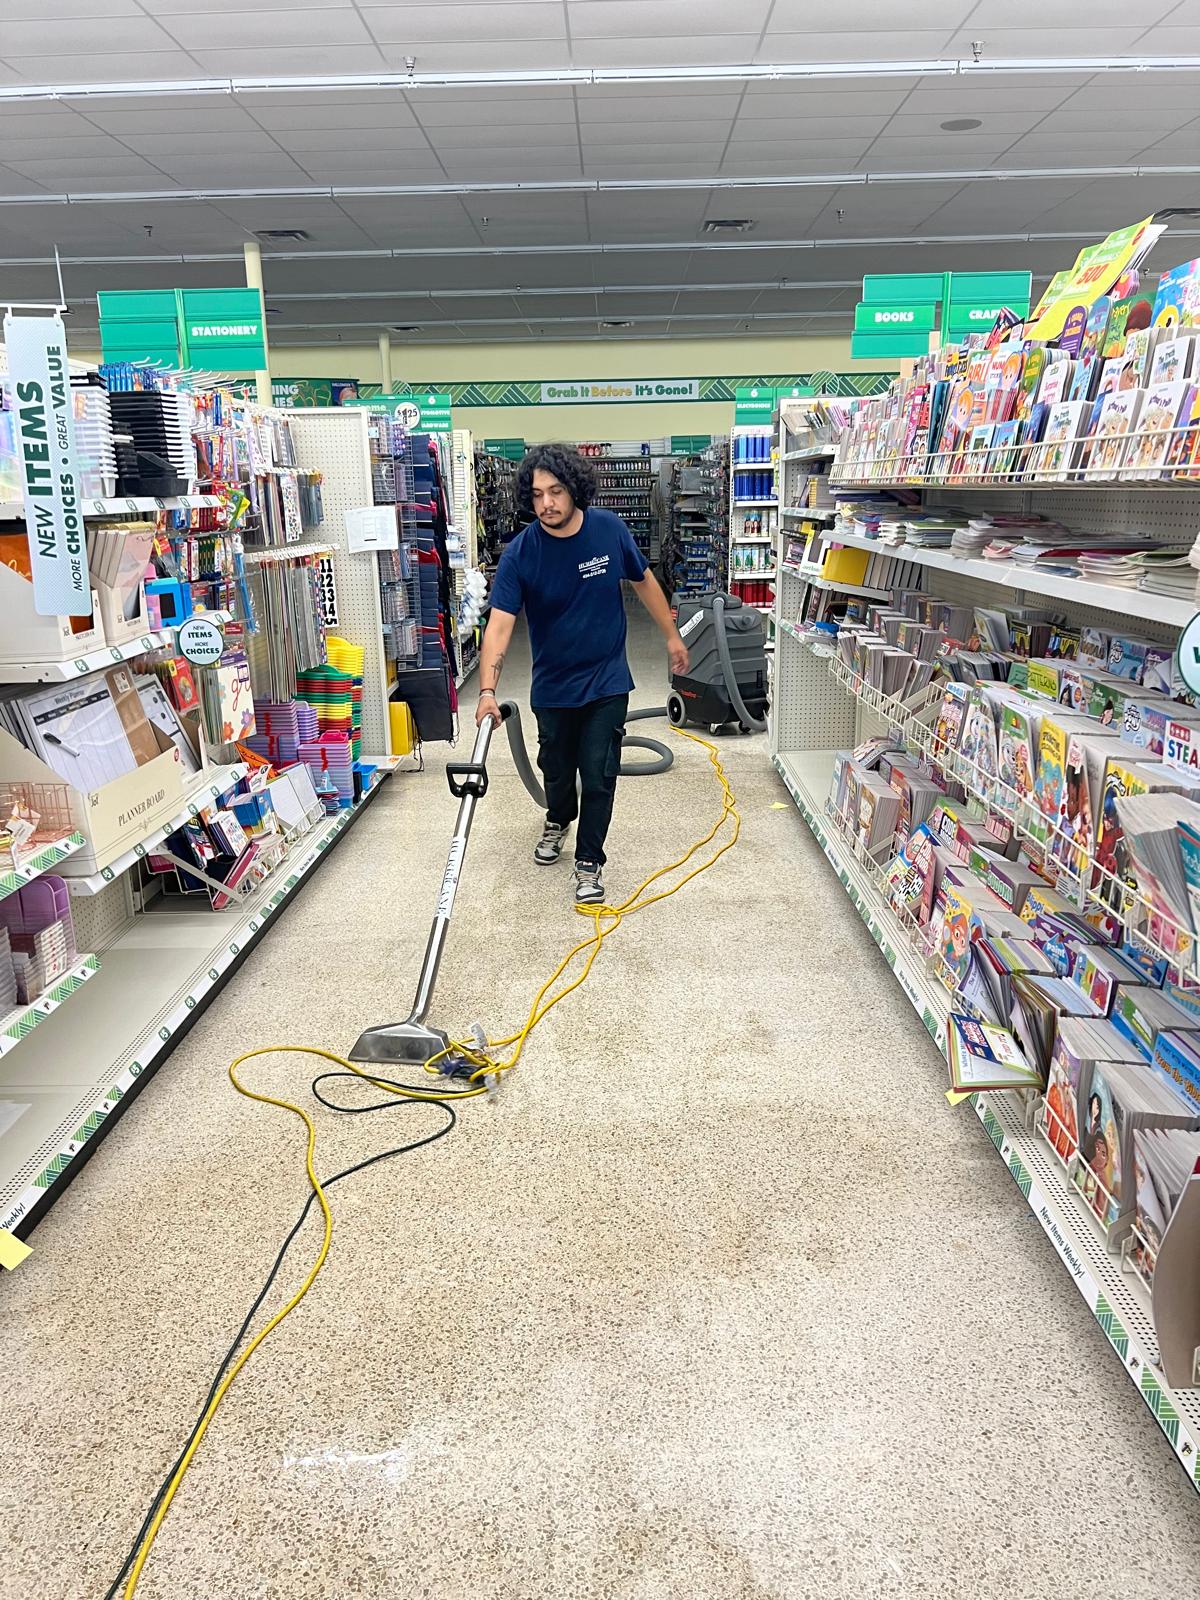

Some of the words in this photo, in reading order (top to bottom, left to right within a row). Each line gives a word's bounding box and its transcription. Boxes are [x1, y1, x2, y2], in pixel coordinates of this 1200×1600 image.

[1076, 263, 1110, 285] 500
[875, 311, 914, 323] BOOKS
[192, 325, 257, 337] STATIONERY
[46, 345, 66, 410] VALUE
[547, 386, 579, 398] Grab
[591, 384, 632, 397] Before
[655, 383, 693, 396] Gone!
[428, 395, 437, 405] 6
[750, 388, 759, 398] 6
[792, 388, 800, 397] 5
[16, 381, 54, 496] ITEMS
[55, 413, 69, 450] GREAT
[60, 473, 81, 555] CHOICES
[33, 504, 58, 559] NEW
[71, 558, 83, 591] MORE
[320, 559, 333, 573] 11
[188, 631, 213, 639] ITEMS
[1168, 739, 1200, 769] STEA
[118, 801, 147, 827] PLANNER
[146, 788, 165, 810] BOARD
[1040, 1206, 1053, 1226] New
[1050, 1223, 1065, 1247] Items
[1063, 1243, 1086, 1279] Weekly!
